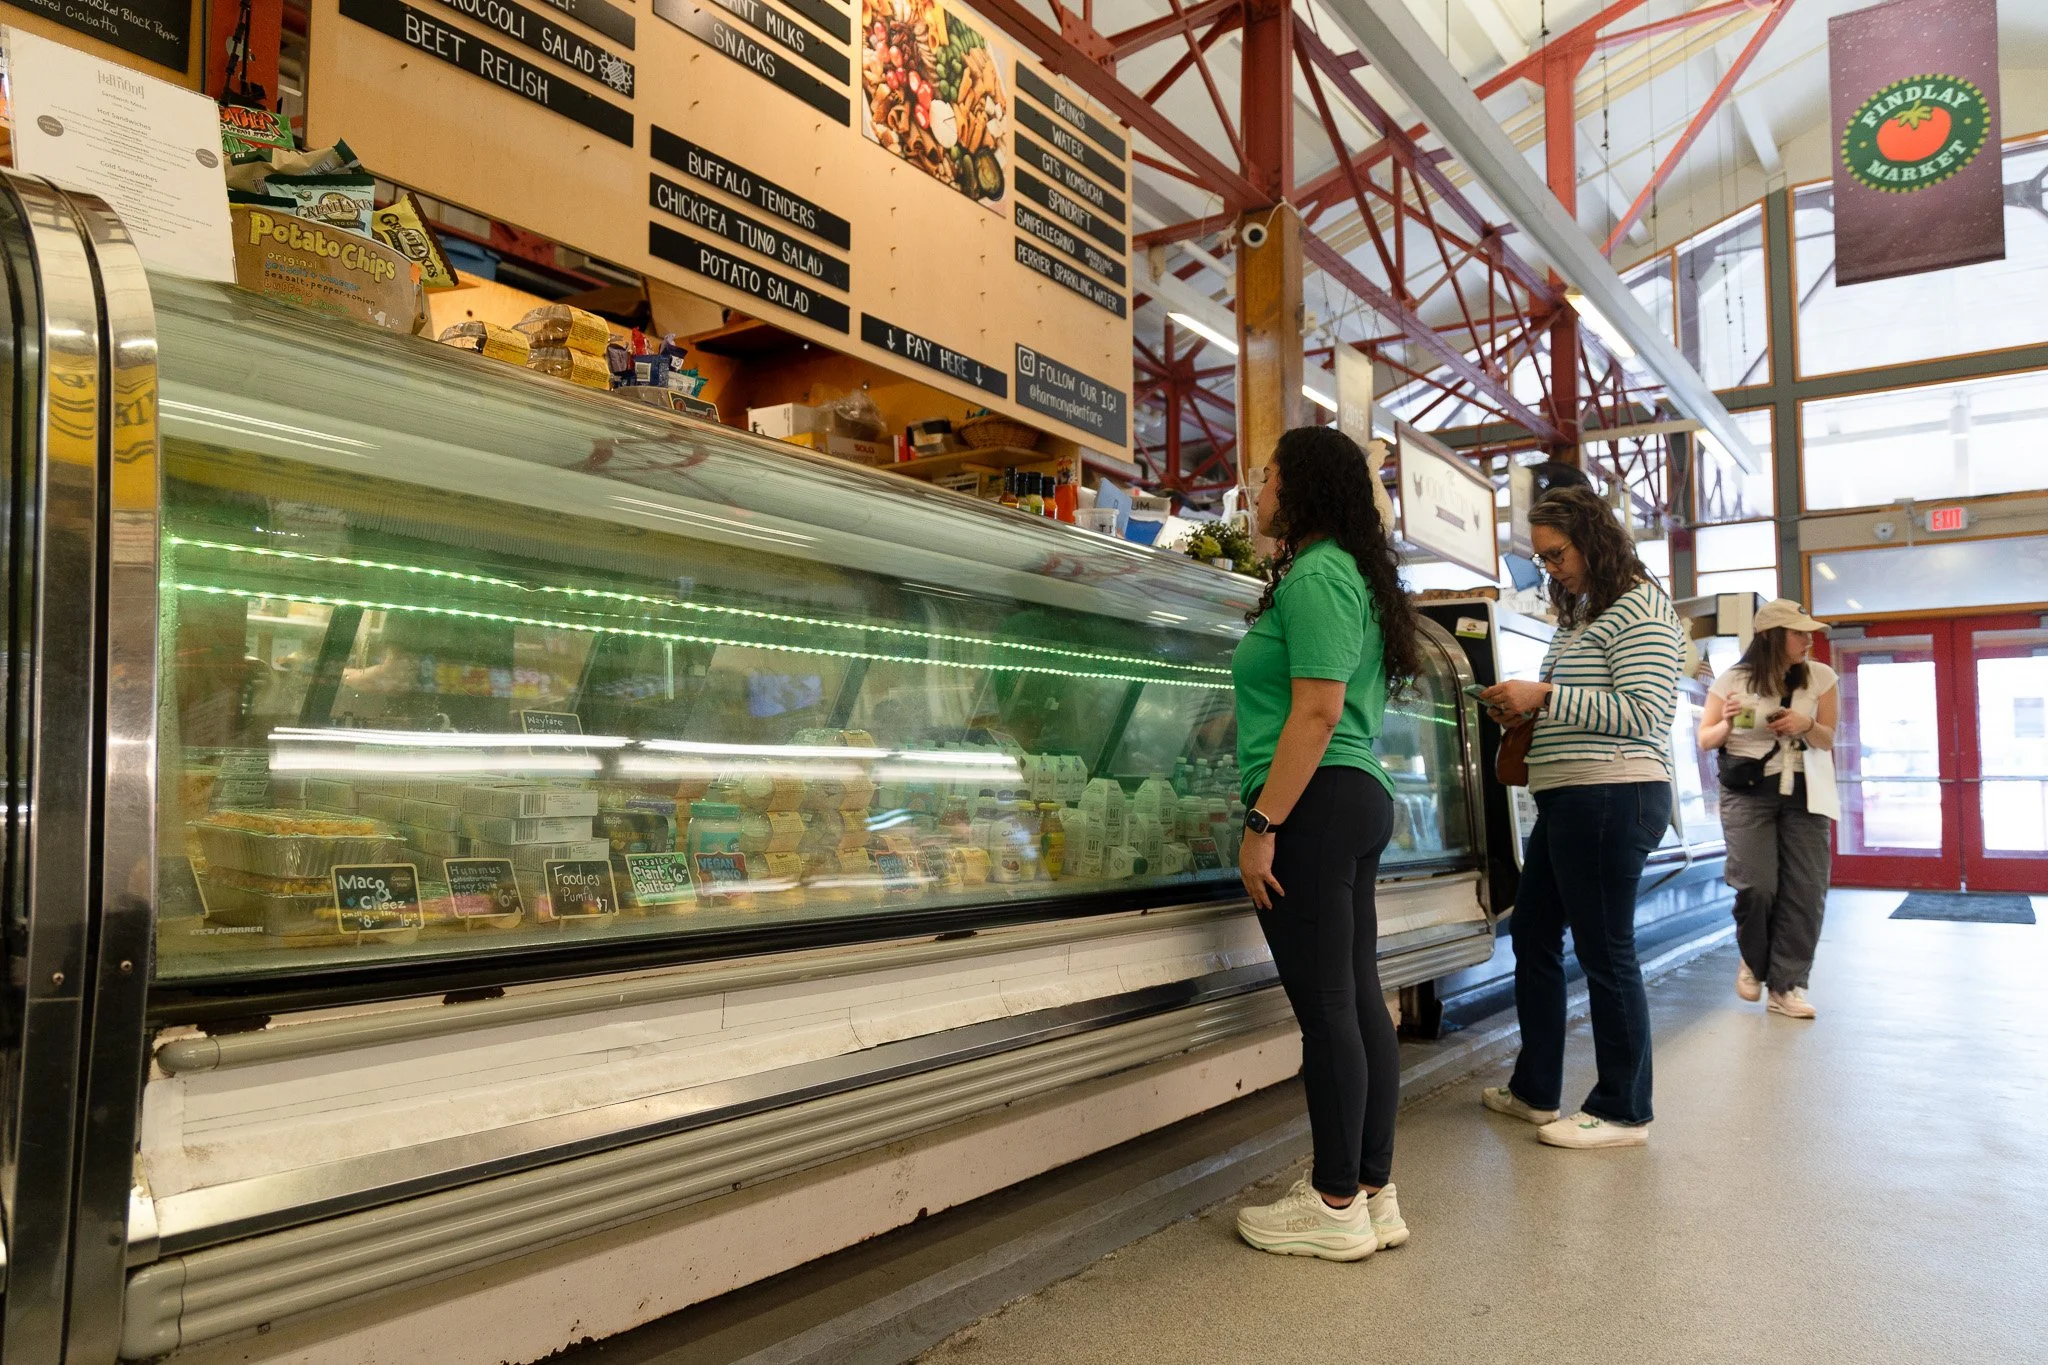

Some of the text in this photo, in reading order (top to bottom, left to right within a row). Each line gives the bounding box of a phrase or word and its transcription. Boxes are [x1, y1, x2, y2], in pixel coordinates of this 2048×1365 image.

[65, 6, 119, 36] Ciabatta
[121, 8, 151, 31] Black
[766, 11, 805, 53] MILKS
[405, 13, 549, 104] BEET RELISH
[541, 27, 595, 73] SALAD
[713, 22, 776, 78] SNACKS
[97, 107, 110, 116] Hot
[111, 112, 152, 131] Sandwiches
[1054, 93, 1086, 130] DRINKS
[1860, 84, 1971, 128] FINDLAY
[1052, 125, 1084, 161] WATER
[100, 160, 159, 183] Cold Sandwiches
[1865, 139, 1968, 182] MARKET
[688, 151, 816, 230] BUFFALO TENDERS
[1065, 168, 1104, 208] KOMBUCHA
[1048, 189, 1092, 231] SPINDRIFT
[657, 184, 727, 236] CHICKPEA
[782, 241, 824, 277] SALAD
[249, 210, 341, 259] Potato
[340, 242, 396, 284] Chips
[267, 252, 318, 269] original
[700, 249, 809, 313] POTATO SALAD
[1017, 243, 1118, 312] PERRIER SPARKLING WATER
[906, 333, 968, 379] PAY HERE
[1039, 362, 1117, 413] FOLLOW OUR IG!
[1932, 508, 1962, 530] EXIT
[527, 714, 564, 728] Wayfare
[450, 865, 501, 876] Hummus
[553, 864, 600, 886] Foodies
[631, 854, 677, 866] unsalted
[632, 865, 666, 881] Plant
[699, 857, 735, 870] VEGAN
[338, 874, 376, 890] Mac
[374, 879, 393, 902] &
[561, 885, 594, 902] Pumfu
[636, 881, 676, 894] Butter
[360, 895, 407, 911] Cheez
[596, 896, 608, 912] $7
